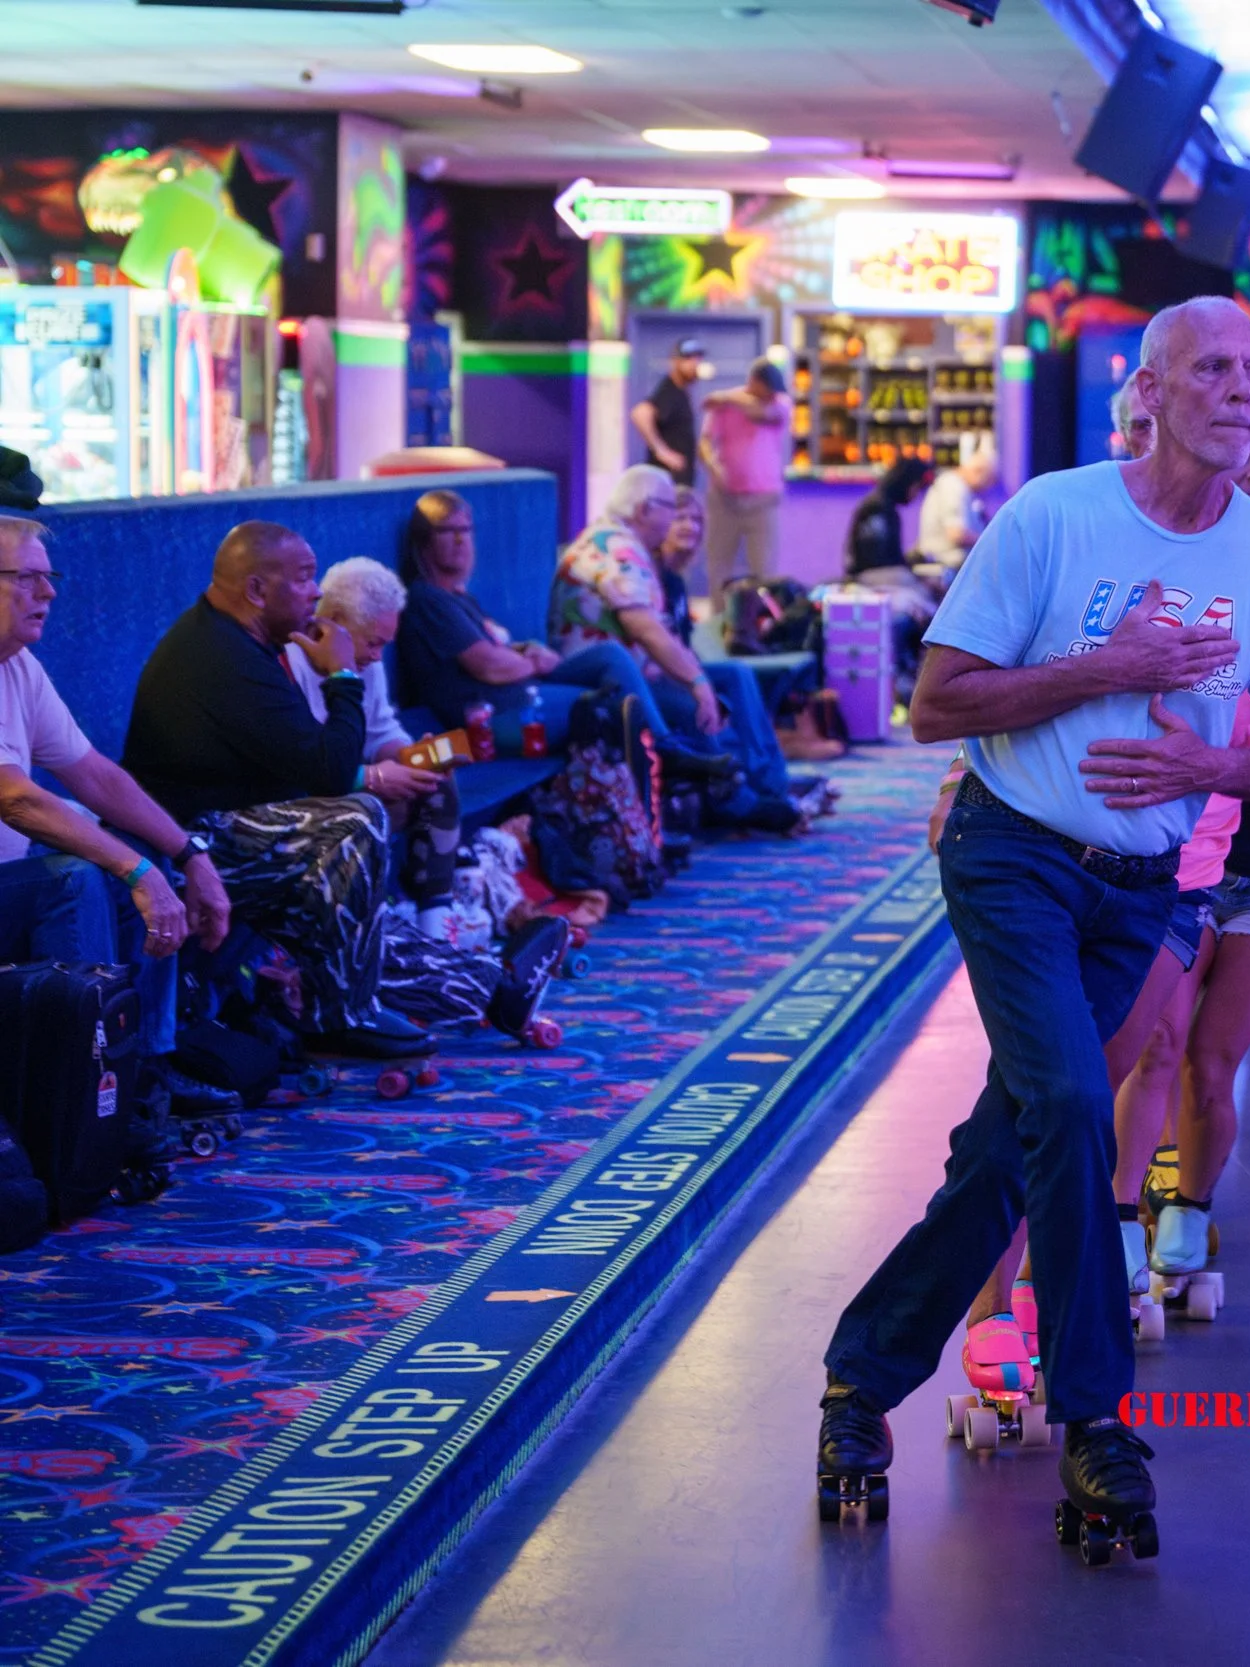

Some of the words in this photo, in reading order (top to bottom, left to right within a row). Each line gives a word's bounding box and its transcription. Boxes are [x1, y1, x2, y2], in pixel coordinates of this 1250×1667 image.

[859, 262, 995, 295] SHOP
[1080, 578, 1235, 647] USA
[636, 1082, 760, 1146] CAUTION
[593, 1151, 699, 1192] STEP
[520, 1199, 656, 1256] DOWN
[136, 1475, 393, 1629] CAUTION
[312, 1387, 467, 1459] STEP
[395, 1340, 511, 1374] UP
